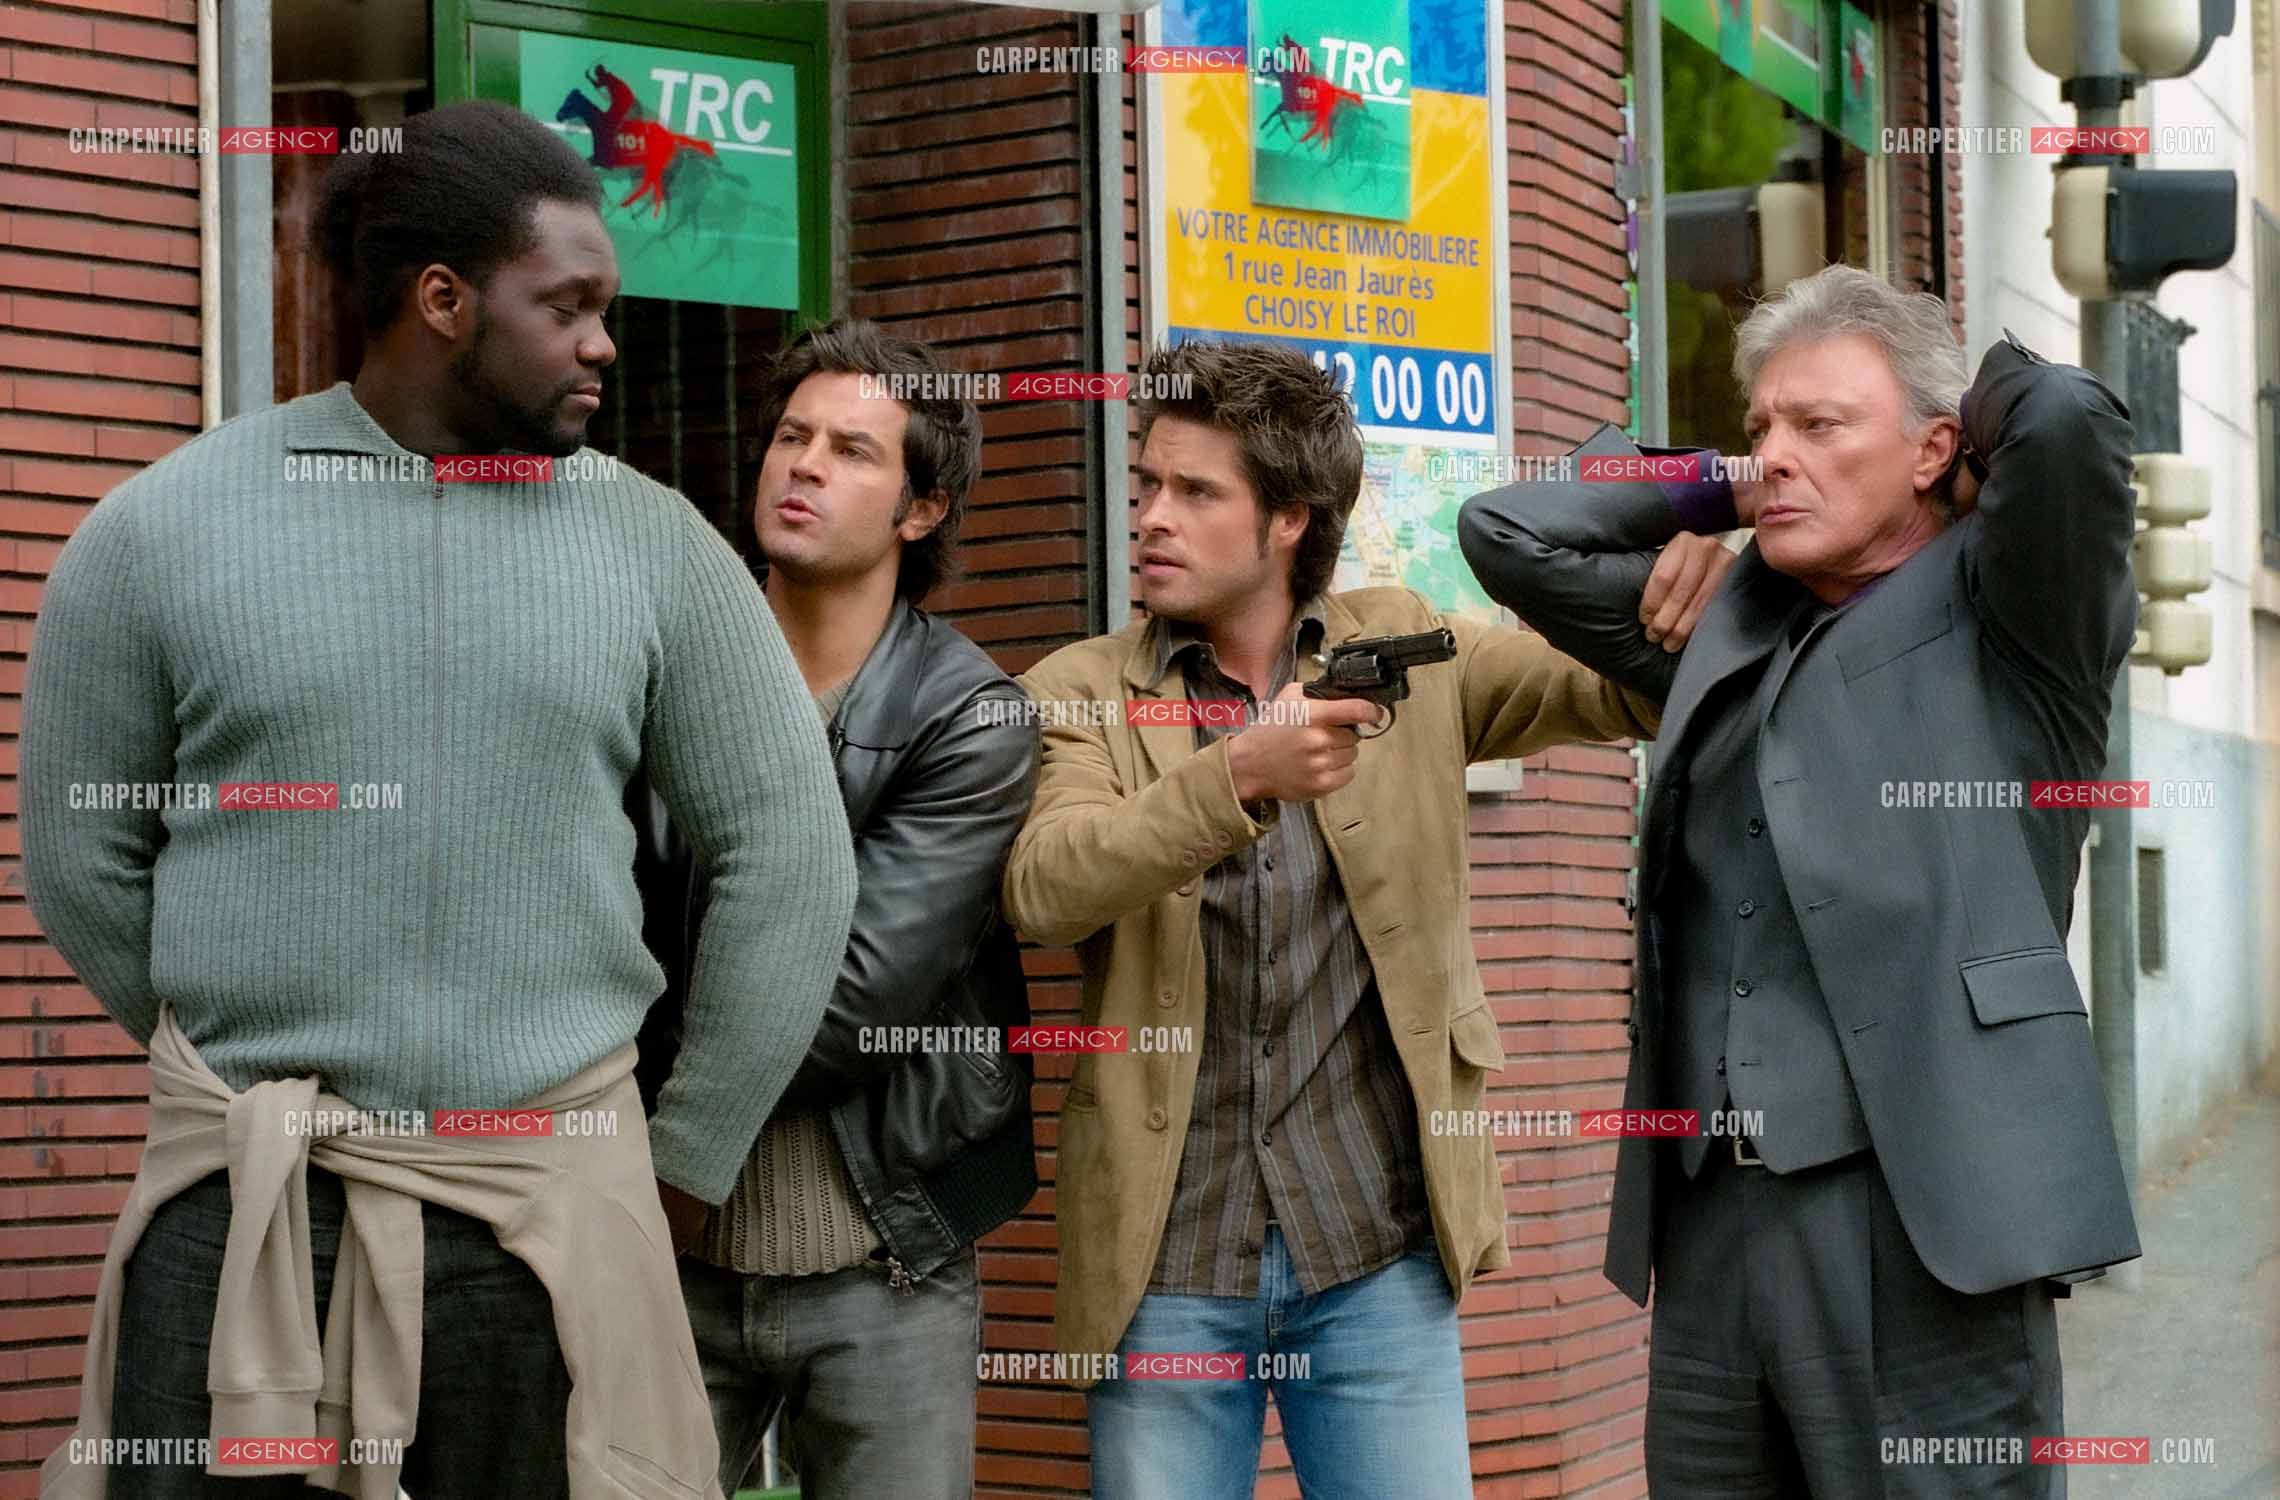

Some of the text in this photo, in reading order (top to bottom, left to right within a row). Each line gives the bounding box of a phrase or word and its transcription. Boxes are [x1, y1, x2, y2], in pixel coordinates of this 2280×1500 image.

[1319, 37, 1405, 96] TRC
[651, 67, 774, 144] TRC
[615, 133, 645, 151] 101
[1177, 207, 1480, 267] VOTRE AGENCE IMMOBILIERE
[1223, 251, 1435, 301] 1 rue Jean Jaurès
[1244, 294, 1416, 338] CHOISY LE ROI
[1371, 354, 1423, 422] 00
[1435, 360, 1486, 427] 00
